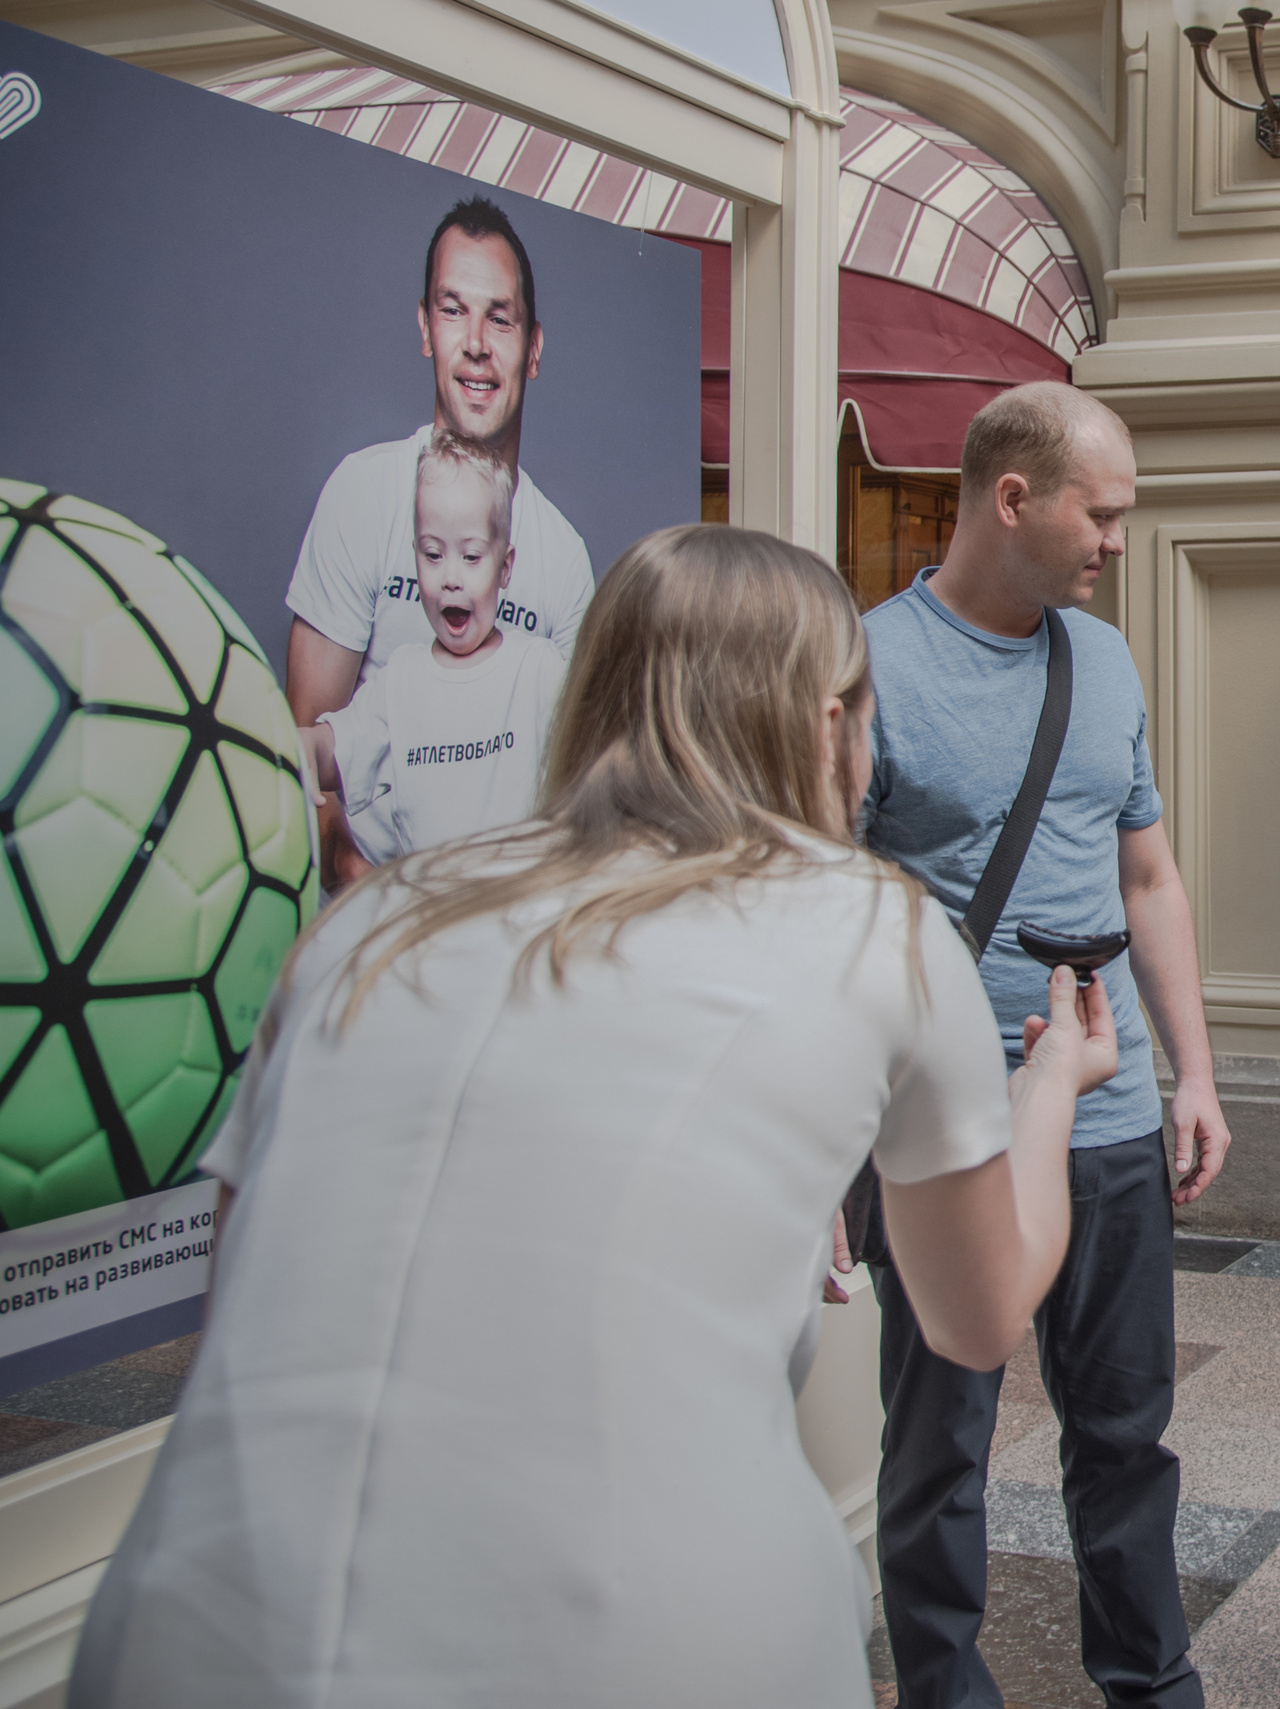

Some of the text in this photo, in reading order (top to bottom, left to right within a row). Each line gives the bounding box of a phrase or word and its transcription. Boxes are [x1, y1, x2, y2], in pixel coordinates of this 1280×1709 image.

[4, 1240, 113, 1282] отправить
[119, 1223, 157, 1249] СМС
[162, 1219, 184, 1238] на
[65, 1275, 89, 1295] на
